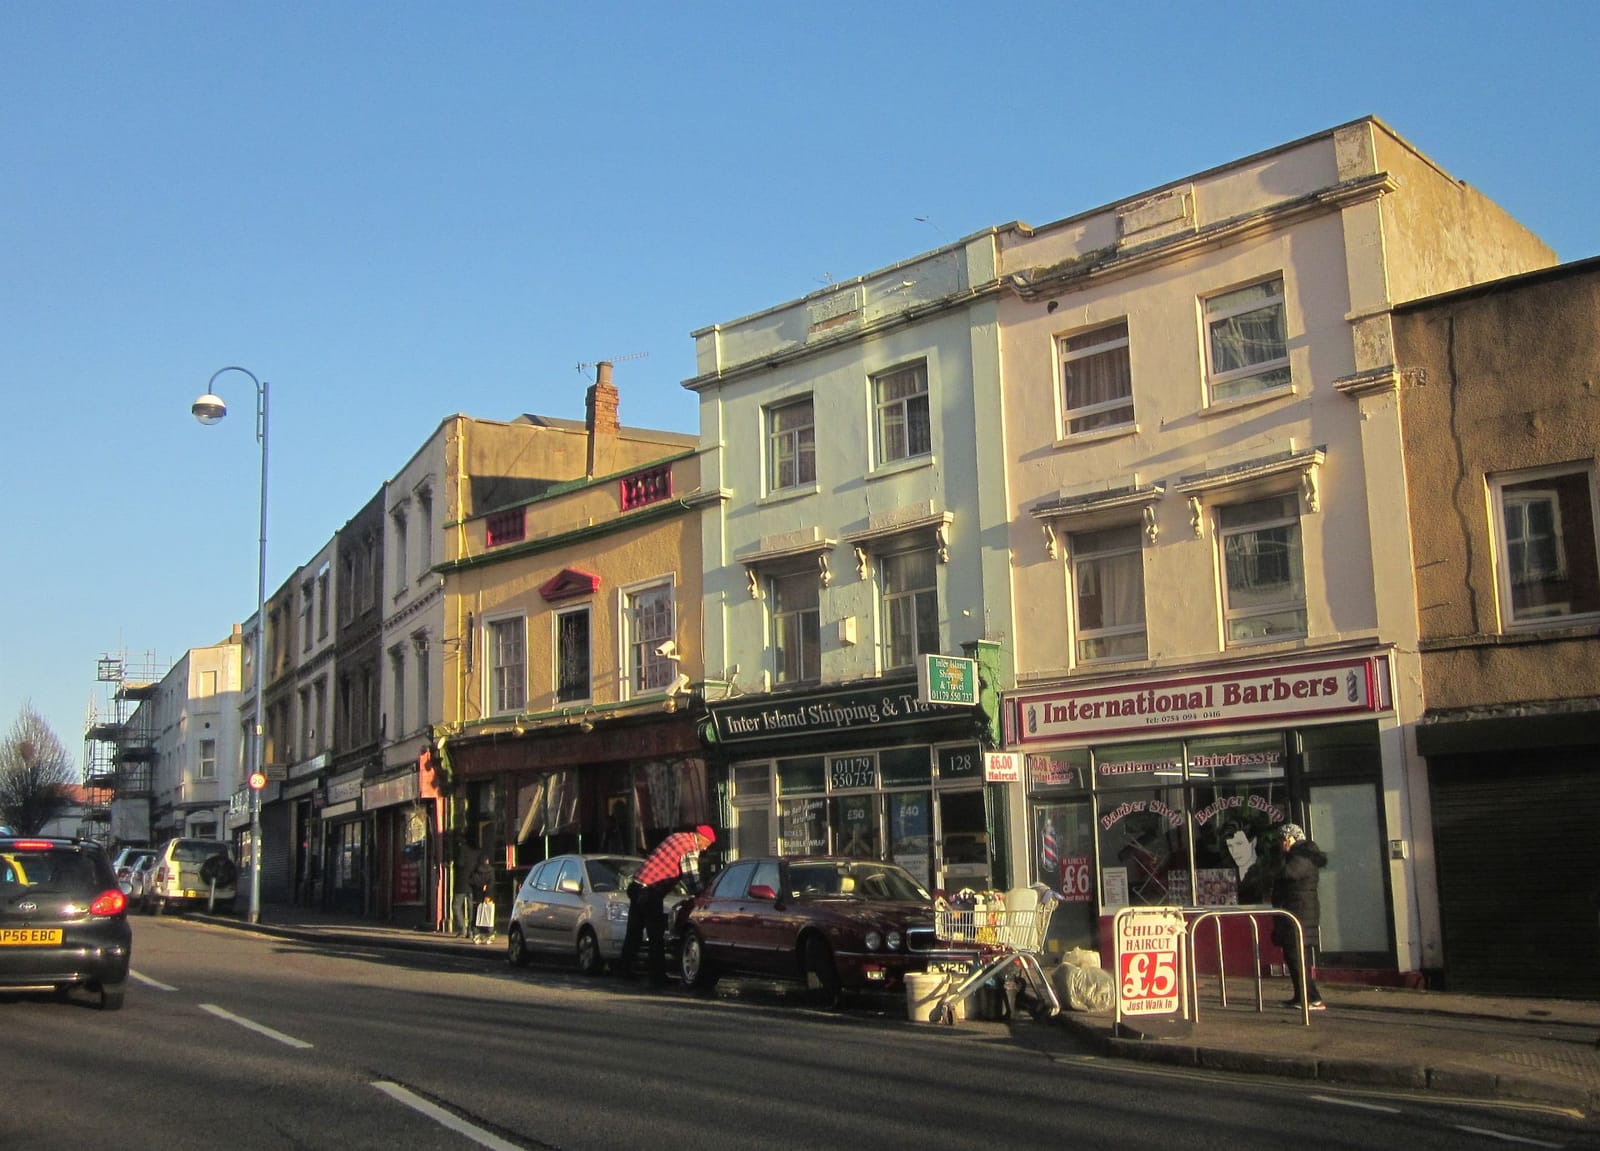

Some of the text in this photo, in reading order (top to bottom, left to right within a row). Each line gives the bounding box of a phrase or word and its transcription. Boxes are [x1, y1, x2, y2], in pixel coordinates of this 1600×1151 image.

[935, 658, 966, 669] Inter Island
[939, 669, 963, 682] Shipping
[940, 681, 964, 690] & Travel
[932, 690, 950, 700] 01179
[962, 693, 972, 702] 737
[1043, 675, 1339, 724] International Barbers
[727, 717, 760, 734] Inter
[761, 708, 807, 731] Island
[808, 702, 880, 727] Shipping
[882, 697, 898, 716] &
[836, 757, 869, 774] 01179
[950, 754, 971, 770] 128
[990, 755, 1012, 770] £6.00
[1193, 752, 1280, 768] Hairdresser
[988, 771, 1017, 780] Haircut
[847, 808, 865, 821] £50
[900, 805, 919, 817] £40
[1101, 800, 1184, 830] Barber Shop
[1195, 794, 1284, 826] Barber Shop
[1063, 865, 1089, 894] £6
[0, 930, 56, 942] P56 EBC
[1123, 924, 1175, 937] CHILD'S
[1126, 938, 1170, 951] HAIRCUT
[1122, 953, 1176, 998] £5
[1127, 999, 1173, 1011] Just Walk In
